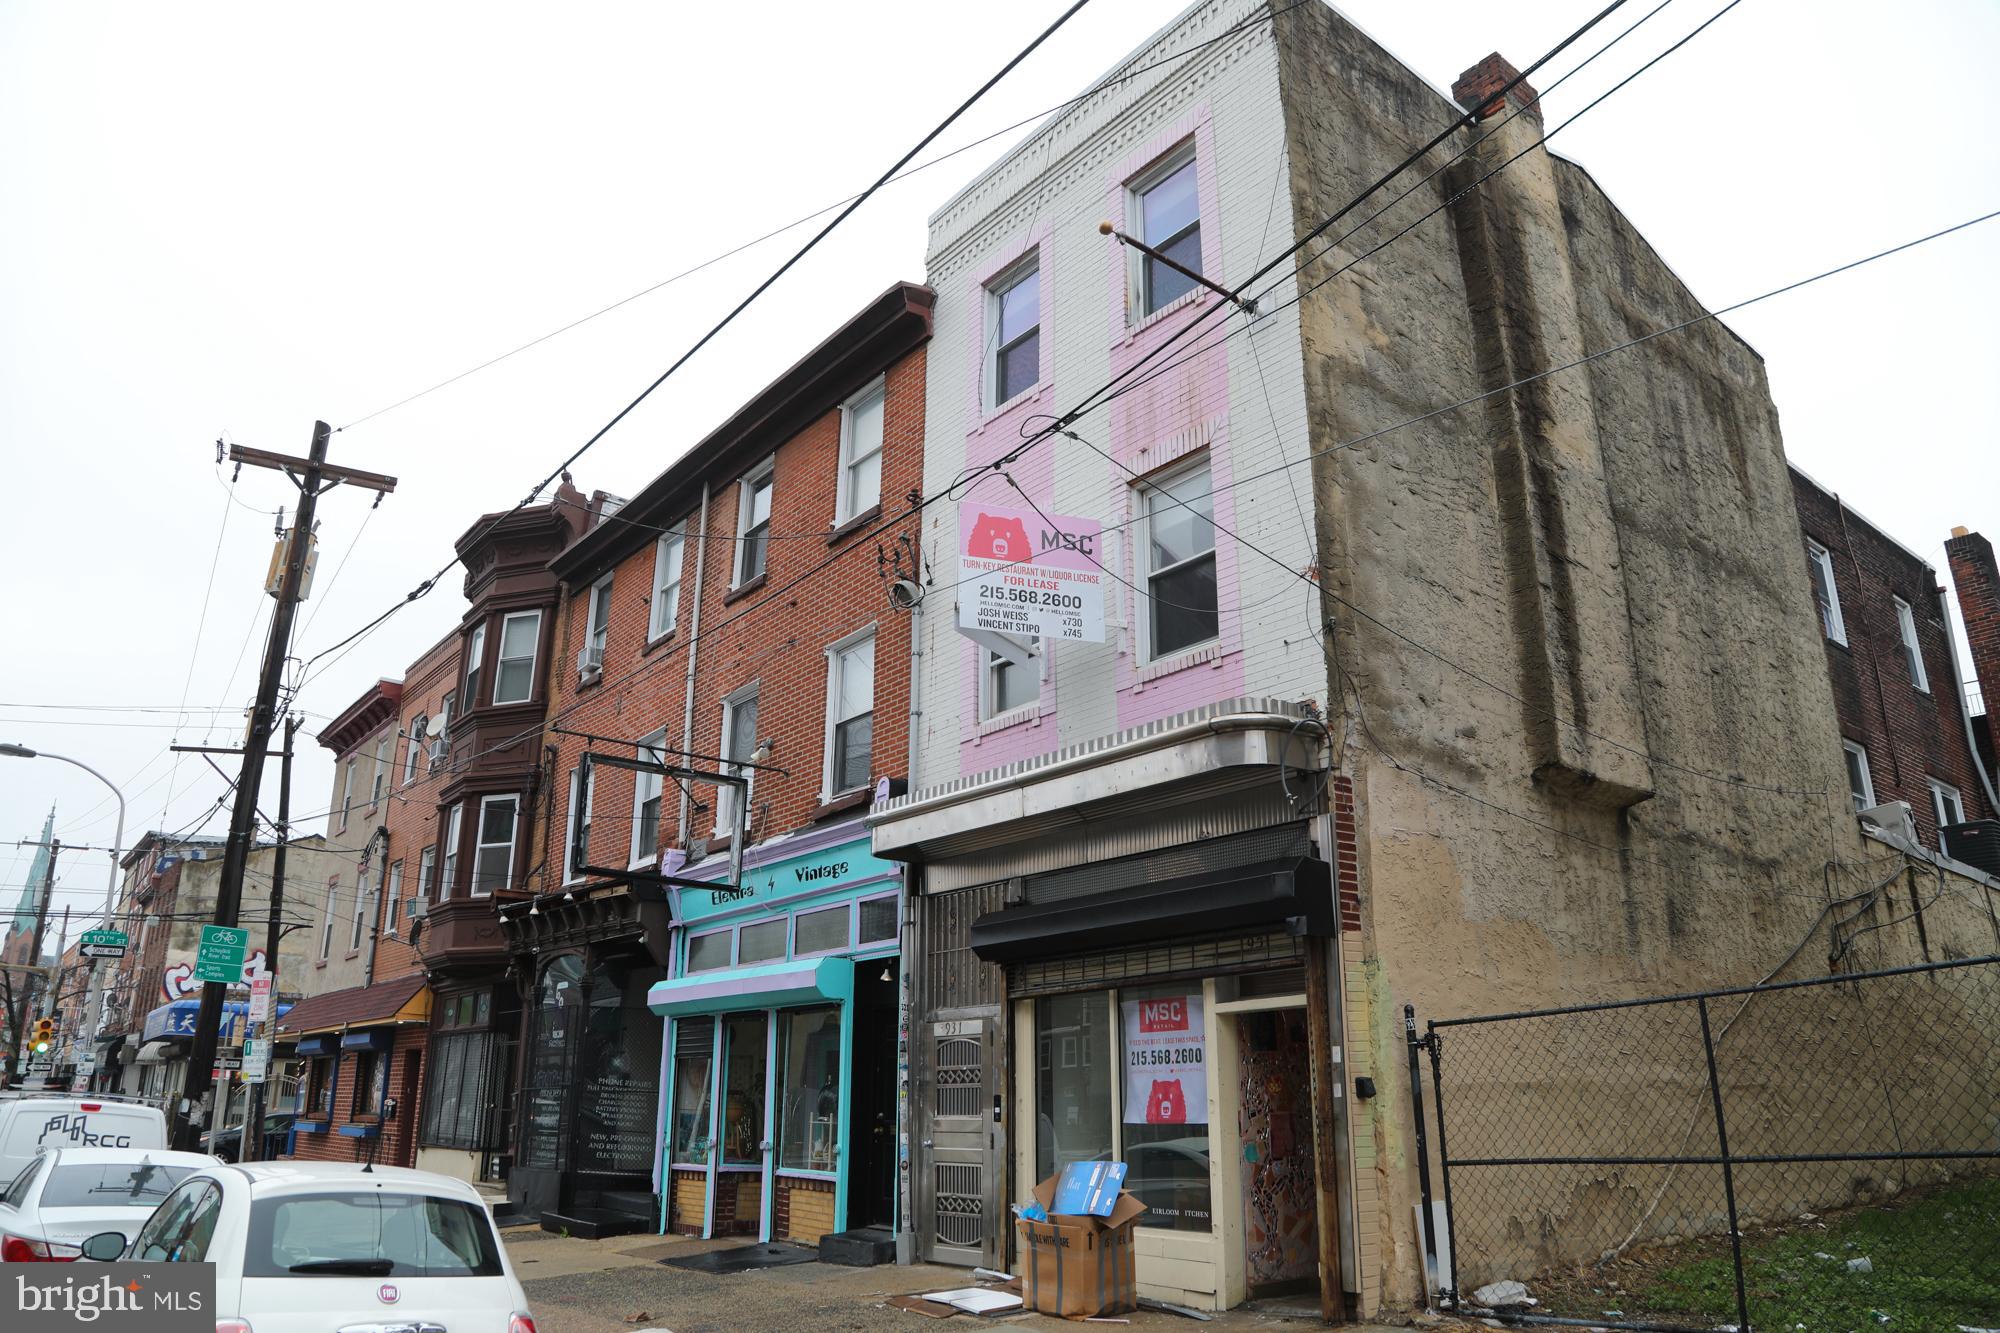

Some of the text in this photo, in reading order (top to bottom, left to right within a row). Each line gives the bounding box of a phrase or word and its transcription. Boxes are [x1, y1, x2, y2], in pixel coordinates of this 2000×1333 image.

[1041, 530, 1093, 556] MSC
[963, 559, 997, 570] TURN-KEY
[997, 562, 1039, 576] RESTAURANT
[1073, 572, 1100, 585] LICENSE
[1004, 576, 1060, 591] FOR LEASE
[980, 585, 1082, 609] 215.568.2600
[979, 600, 1025, 611] HELLOMSC.COM
[977, 607, 1083, 628] JOSH WEISS x730
[977, 618, 1083, 639] VINCENT STIPO x745
[795, 861, 849, 883] Vintage
[205, 970, 225, 978] Complex
[206, 964, 221, 972] Sports
[1145, 1002, 1181, 1024] MSC
[945, 1022, 962, 1035] 931
[1131, 1048, 1202, 1066] 215.568.2600
[598, 1077, 623, 1086] PHONE
[82, 1134, 131, 1148] RCG
[590, 1133, 609, 1141] NEW,
[596, 1151, 641, 1160] ELECTRONICS
[1152, 1207, 1209, 1218] EIRLOOM ITCHEN
